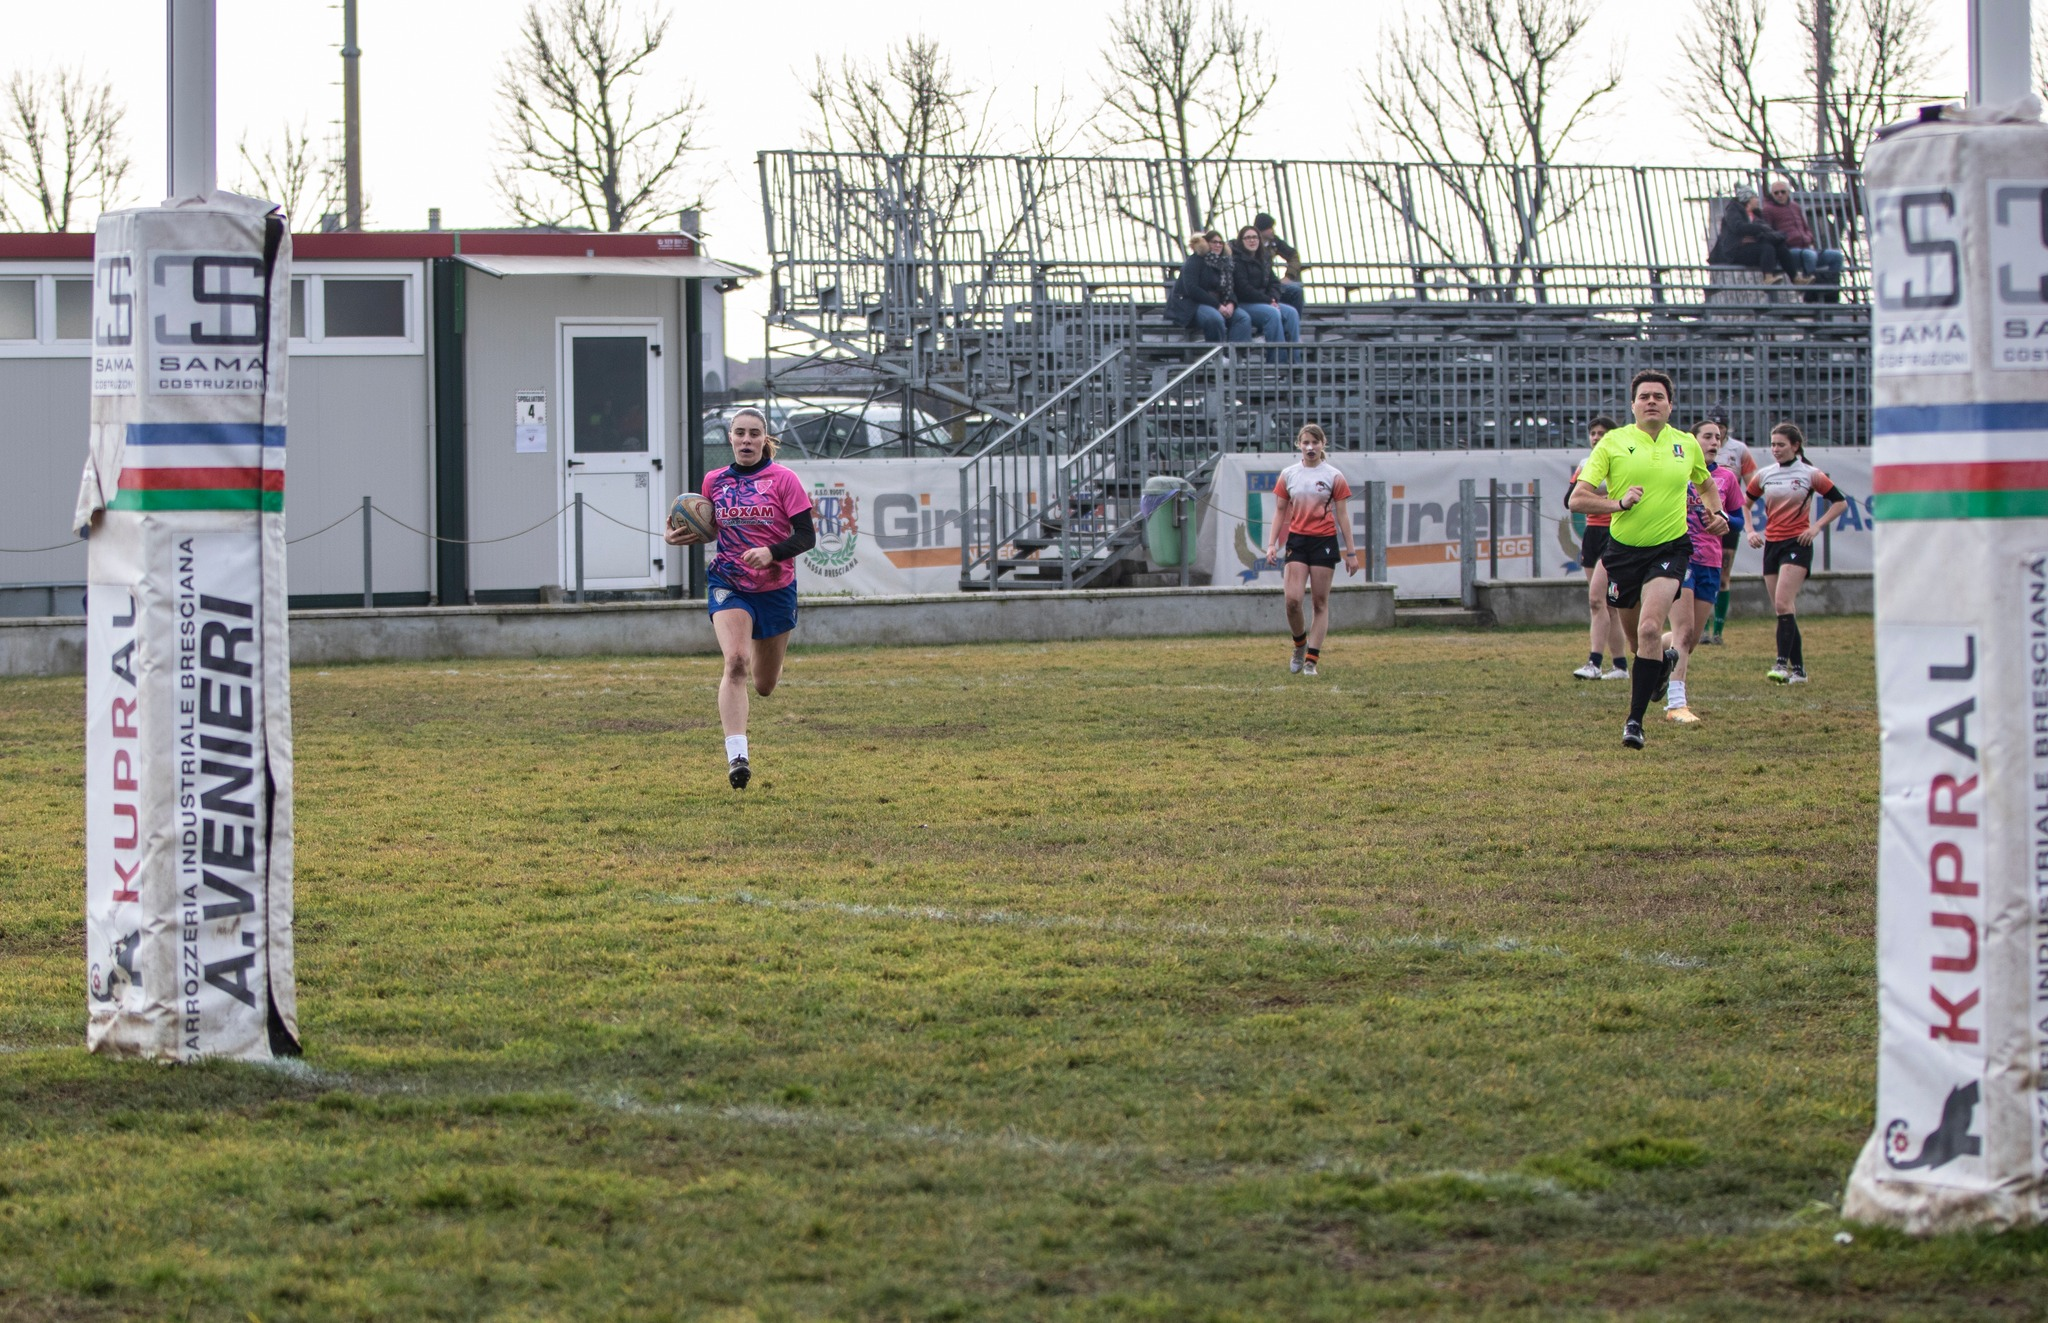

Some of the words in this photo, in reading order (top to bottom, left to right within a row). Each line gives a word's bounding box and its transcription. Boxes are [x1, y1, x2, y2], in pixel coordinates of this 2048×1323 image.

[1880, 323, 1965, 345] SAMA
[96, 358, 134, 373] SAMA
[160, 357, 270, 374] SAMA
[528, 404, 535, 418] 4
[721, 506, 774, 518] LOXAM
[824, 557, 858, 577] BRESCIANA
[179, 538, 196, 689] BRESCIANA
[112, 594, 140, 902] KUPRAL
[180, 699, 198, 873] INDUSTRIALE
[1927, 634, 1980, 1044] KUPRAL
